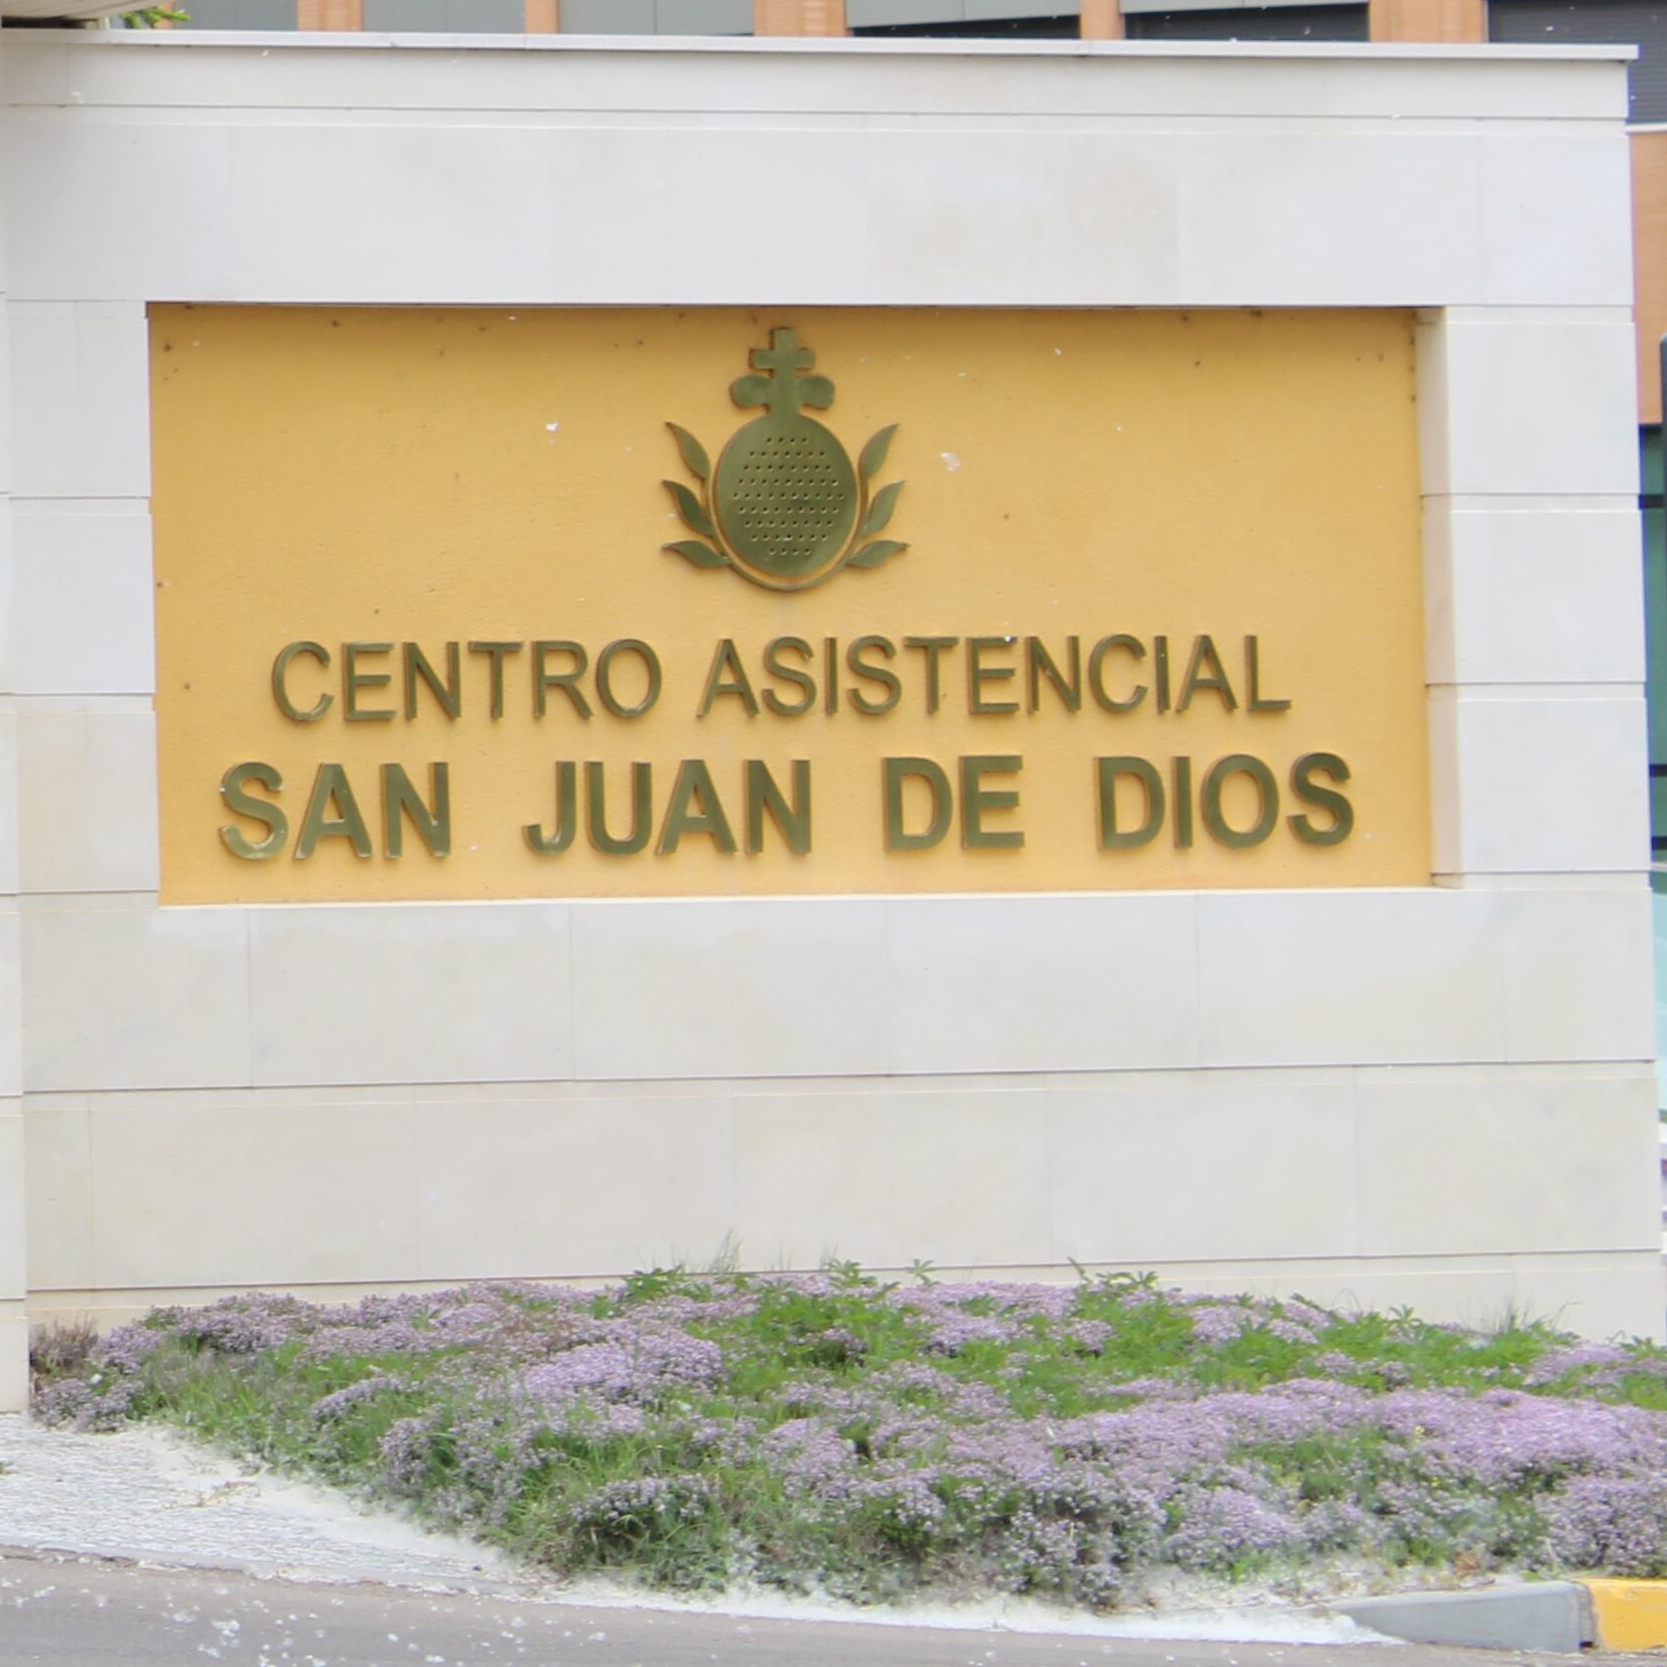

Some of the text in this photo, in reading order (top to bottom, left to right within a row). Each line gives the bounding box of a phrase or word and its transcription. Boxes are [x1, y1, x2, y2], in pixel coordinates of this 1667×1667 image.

[270, 634, 1293, 723] CENTRO ASISTENCIAL
[218, 751, 1355, 859] SAN JUAN DE DIOS
